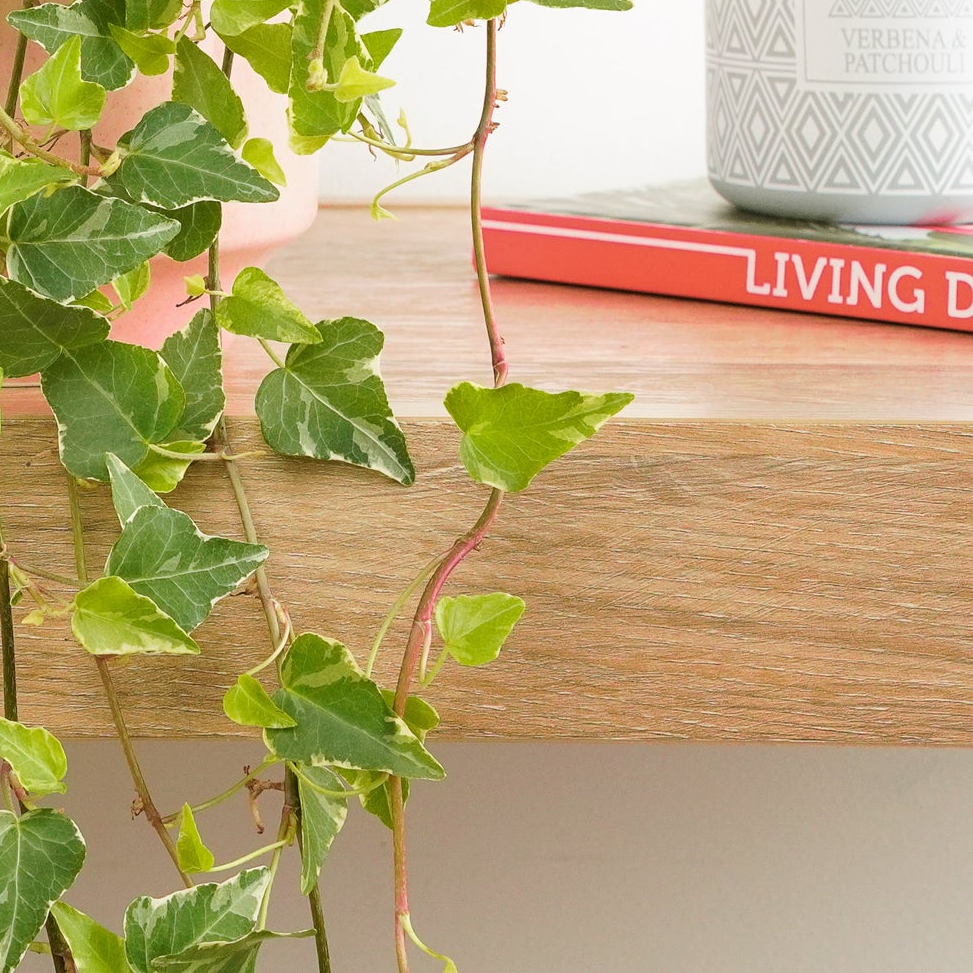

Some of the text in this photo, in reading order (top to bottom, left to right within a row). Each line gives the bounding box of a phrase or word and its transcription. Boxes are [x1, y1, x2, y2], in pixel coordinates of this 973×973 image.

[841, 28, 967, 50] VERBENA &
[843, 52, 965, 74] PATCHOULI
[746, 251, 925, 314] LIVING
